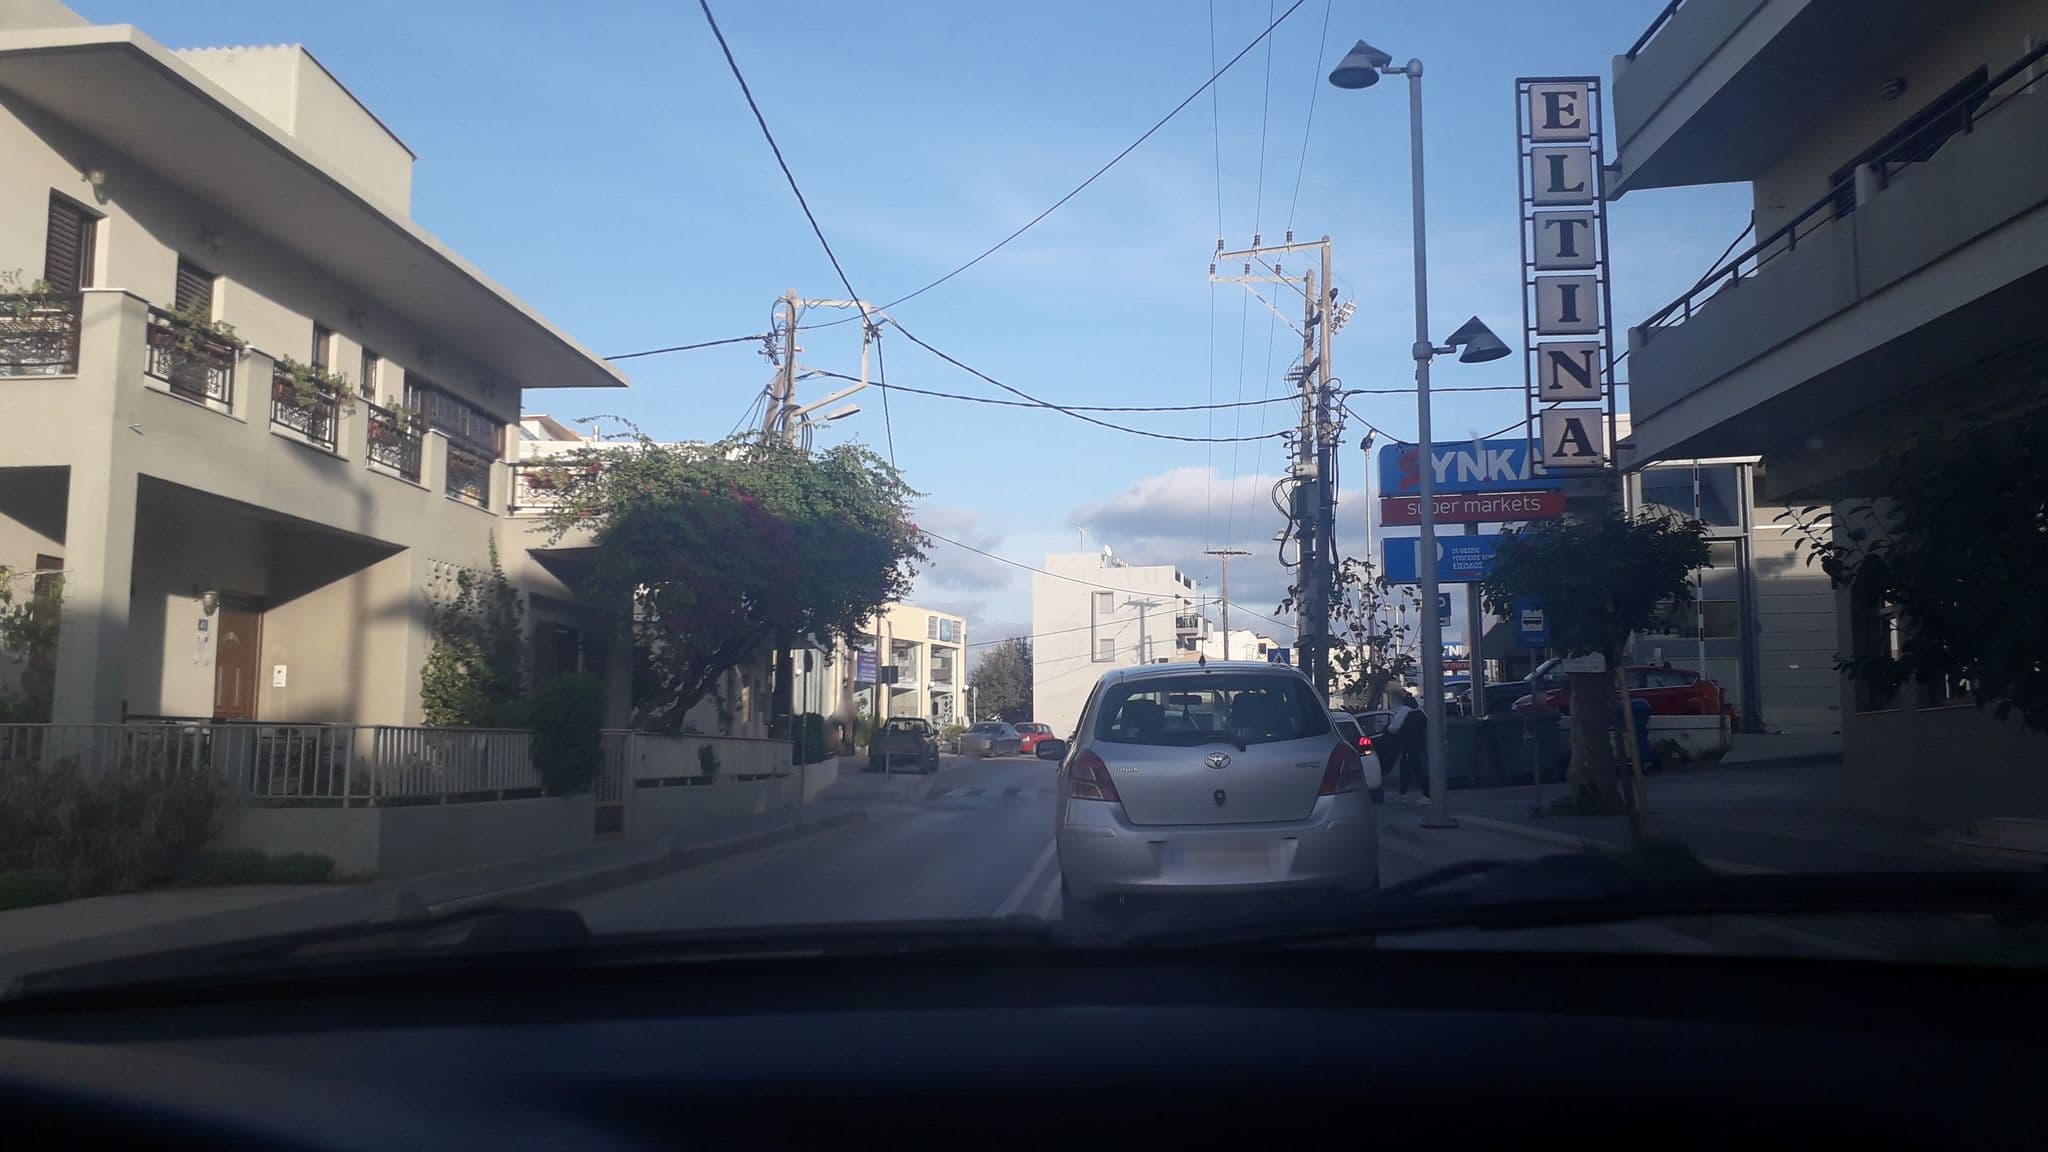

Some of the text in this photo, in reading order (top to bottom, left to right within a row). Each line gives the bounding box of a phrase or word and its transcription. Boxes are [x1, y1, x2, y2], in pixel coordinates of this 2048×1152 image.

[1541, 90, 1598, 458] ELTINA
[1464, 497, 1541, 512] markets
[1452, 562, 1484, 570] ΕΙΣΟΔΟΣ
